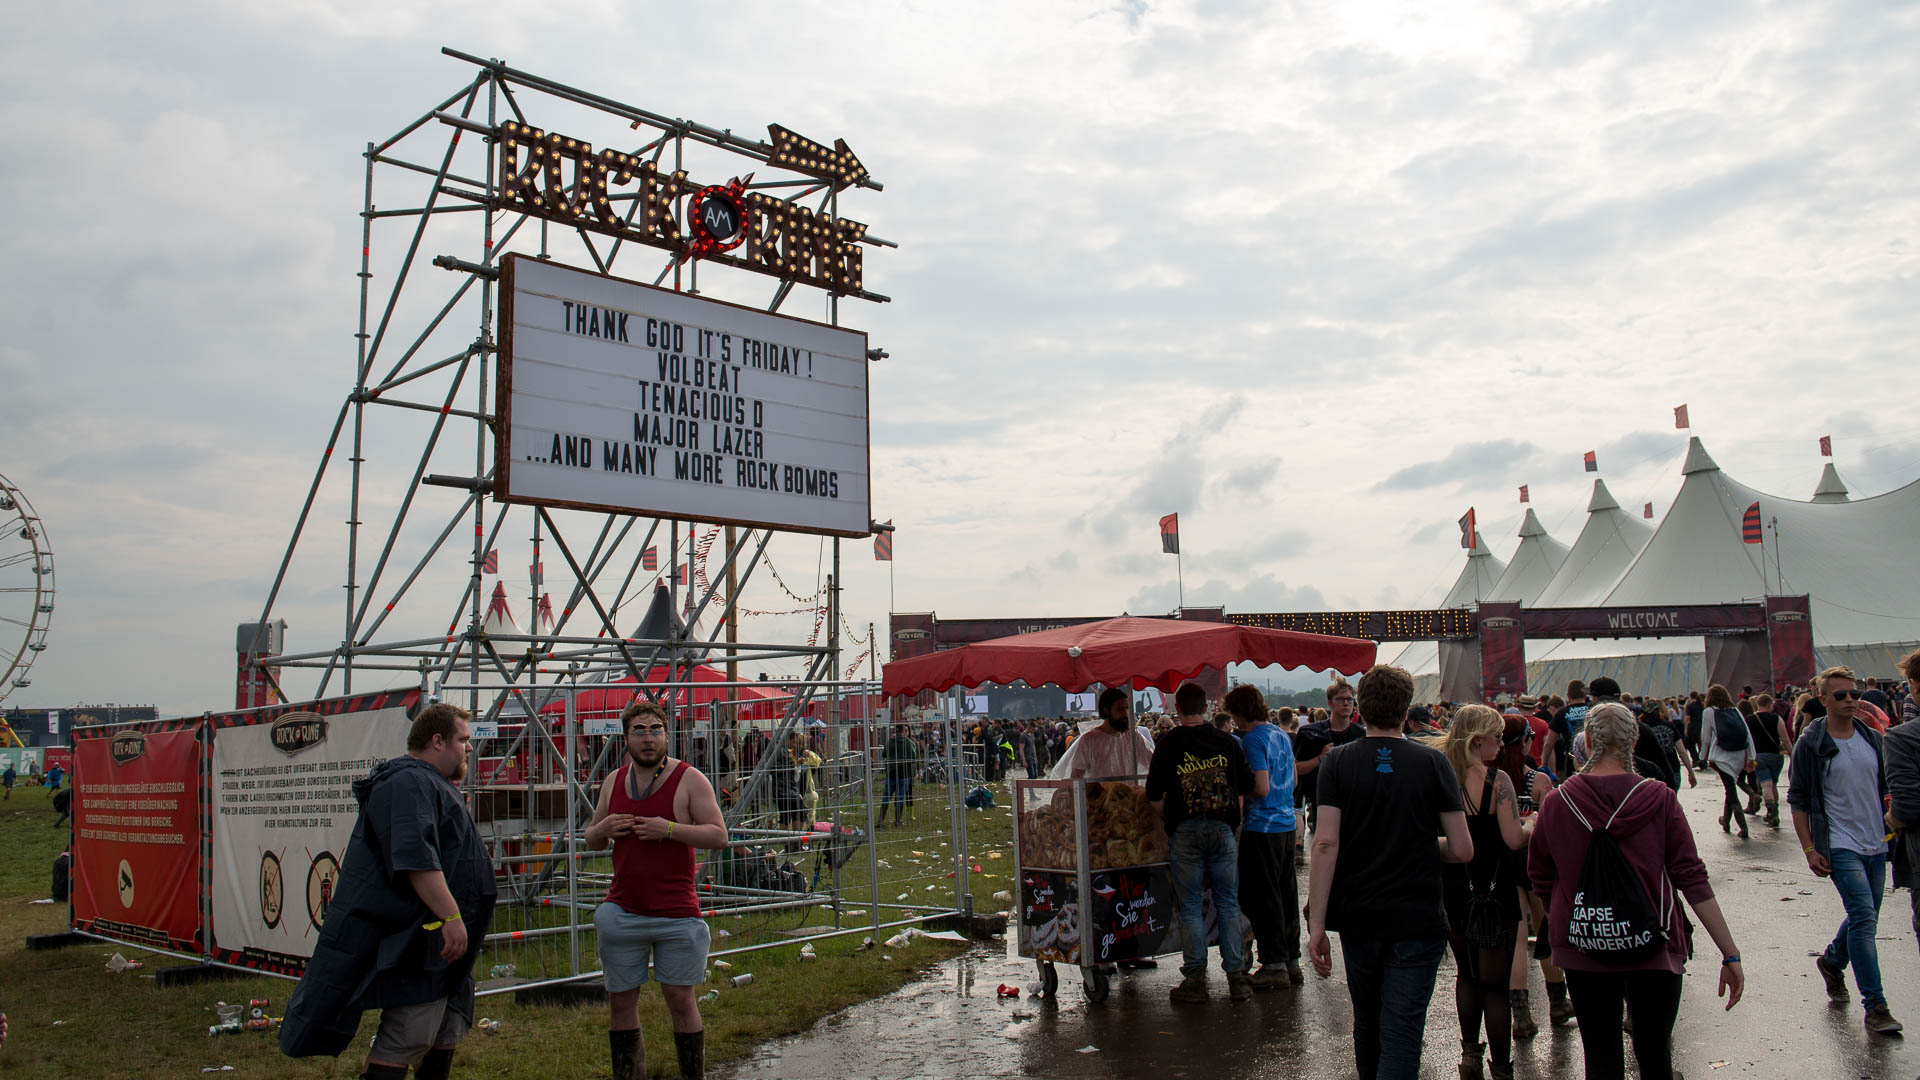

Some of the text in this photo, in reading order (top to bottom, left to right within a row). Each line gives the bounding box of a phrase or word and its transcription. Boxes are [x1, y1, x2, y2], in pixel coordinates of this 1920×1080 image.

[501, 120, 868, 294] ROCK AM RING
[563, 301, 628, 343] THANK
[647, 318, 684, 354] GOD
[699, 328, 730, 362] IT'S
[658, 352, 740, 394] VOLBEAT
[639, 380, 763, 428] TENACIOUS D
[634, 413, 764, 459] MAJOR LAZER
[604, 441, 658, 476] MANY
[675, 452, 723, 484] MORE
[737, 460, 780, 492] ROCK
[784, 466, 838, 498] BOMBS
[1387, 610, 1470, 637] NORTH
[1608, 612, 1680, 629] WELCOME
[276, 724, 320, 744] ROCK RING
[1116, 902, 1138, 928] Sie
[1570, 920, 1589, 936] HAT
